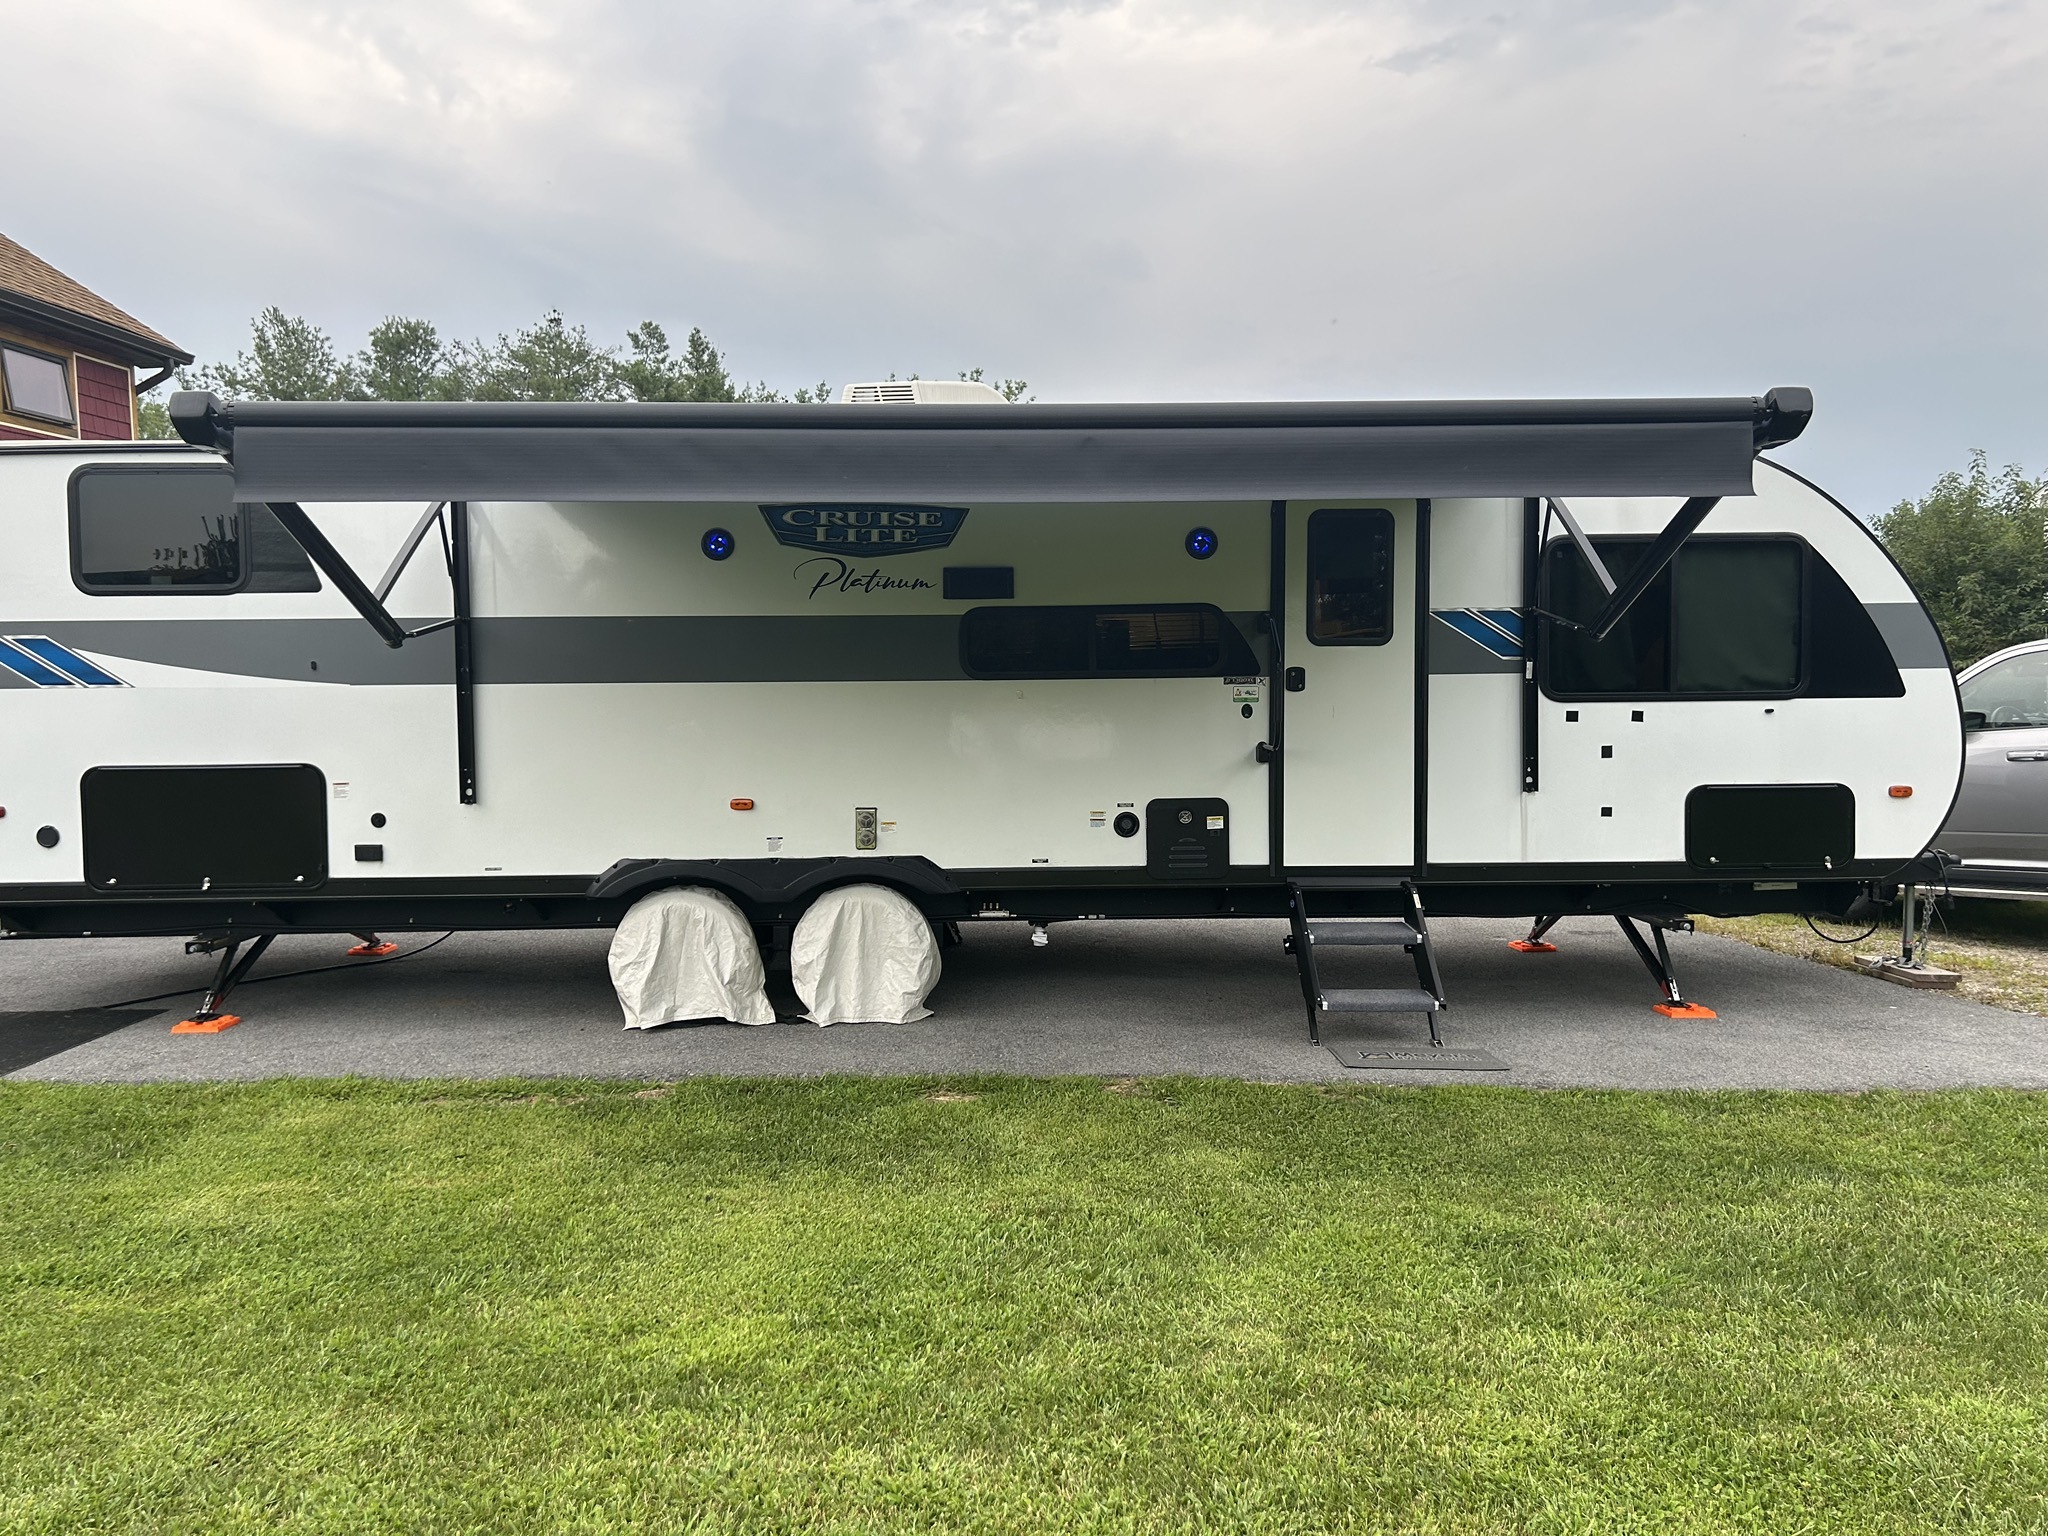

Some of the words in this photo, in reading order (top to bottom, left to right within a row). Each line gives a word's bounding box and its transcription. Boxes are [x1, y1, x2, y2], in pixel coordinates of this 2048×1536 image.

[782, 509, 942, 527] CRUISE
[813, 526, 918, 544] LITE
[793, 558, 937, 599] Platinum
